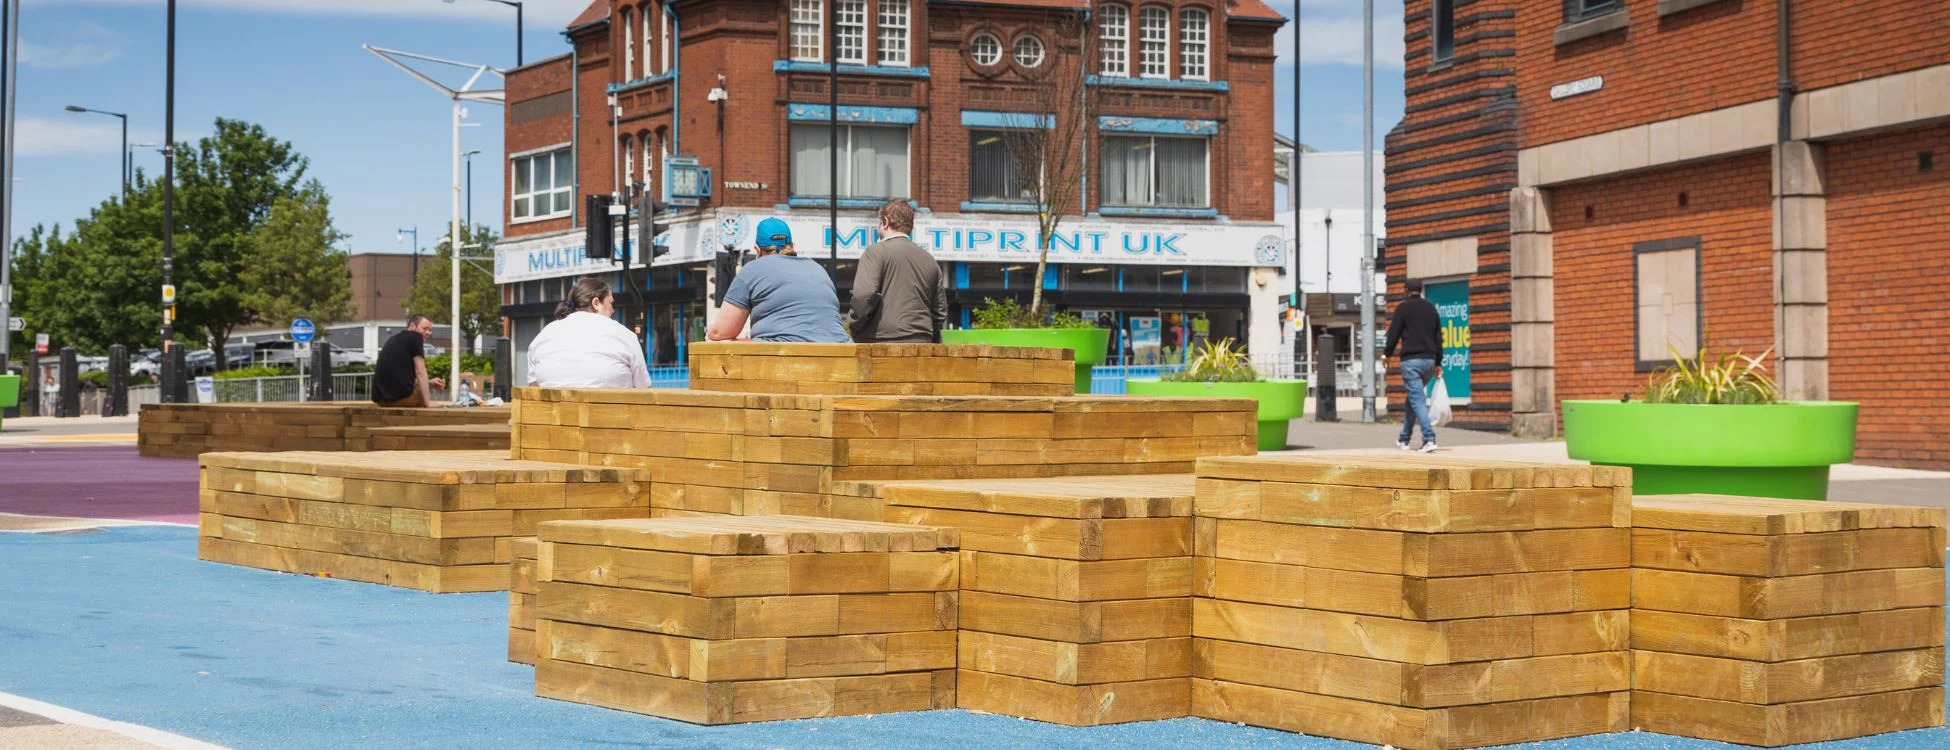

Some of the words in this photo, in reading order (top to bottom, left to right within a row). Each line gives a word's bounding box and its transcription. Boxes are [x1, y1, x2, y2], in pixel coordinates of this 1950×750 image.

[528, 237, 636, 273] MULTIPNT
[823, 224, 1109, 256] MTIPRINT
[1122, 230, 1188, 257] UK
[1441, 319, 1471, 348] alue
